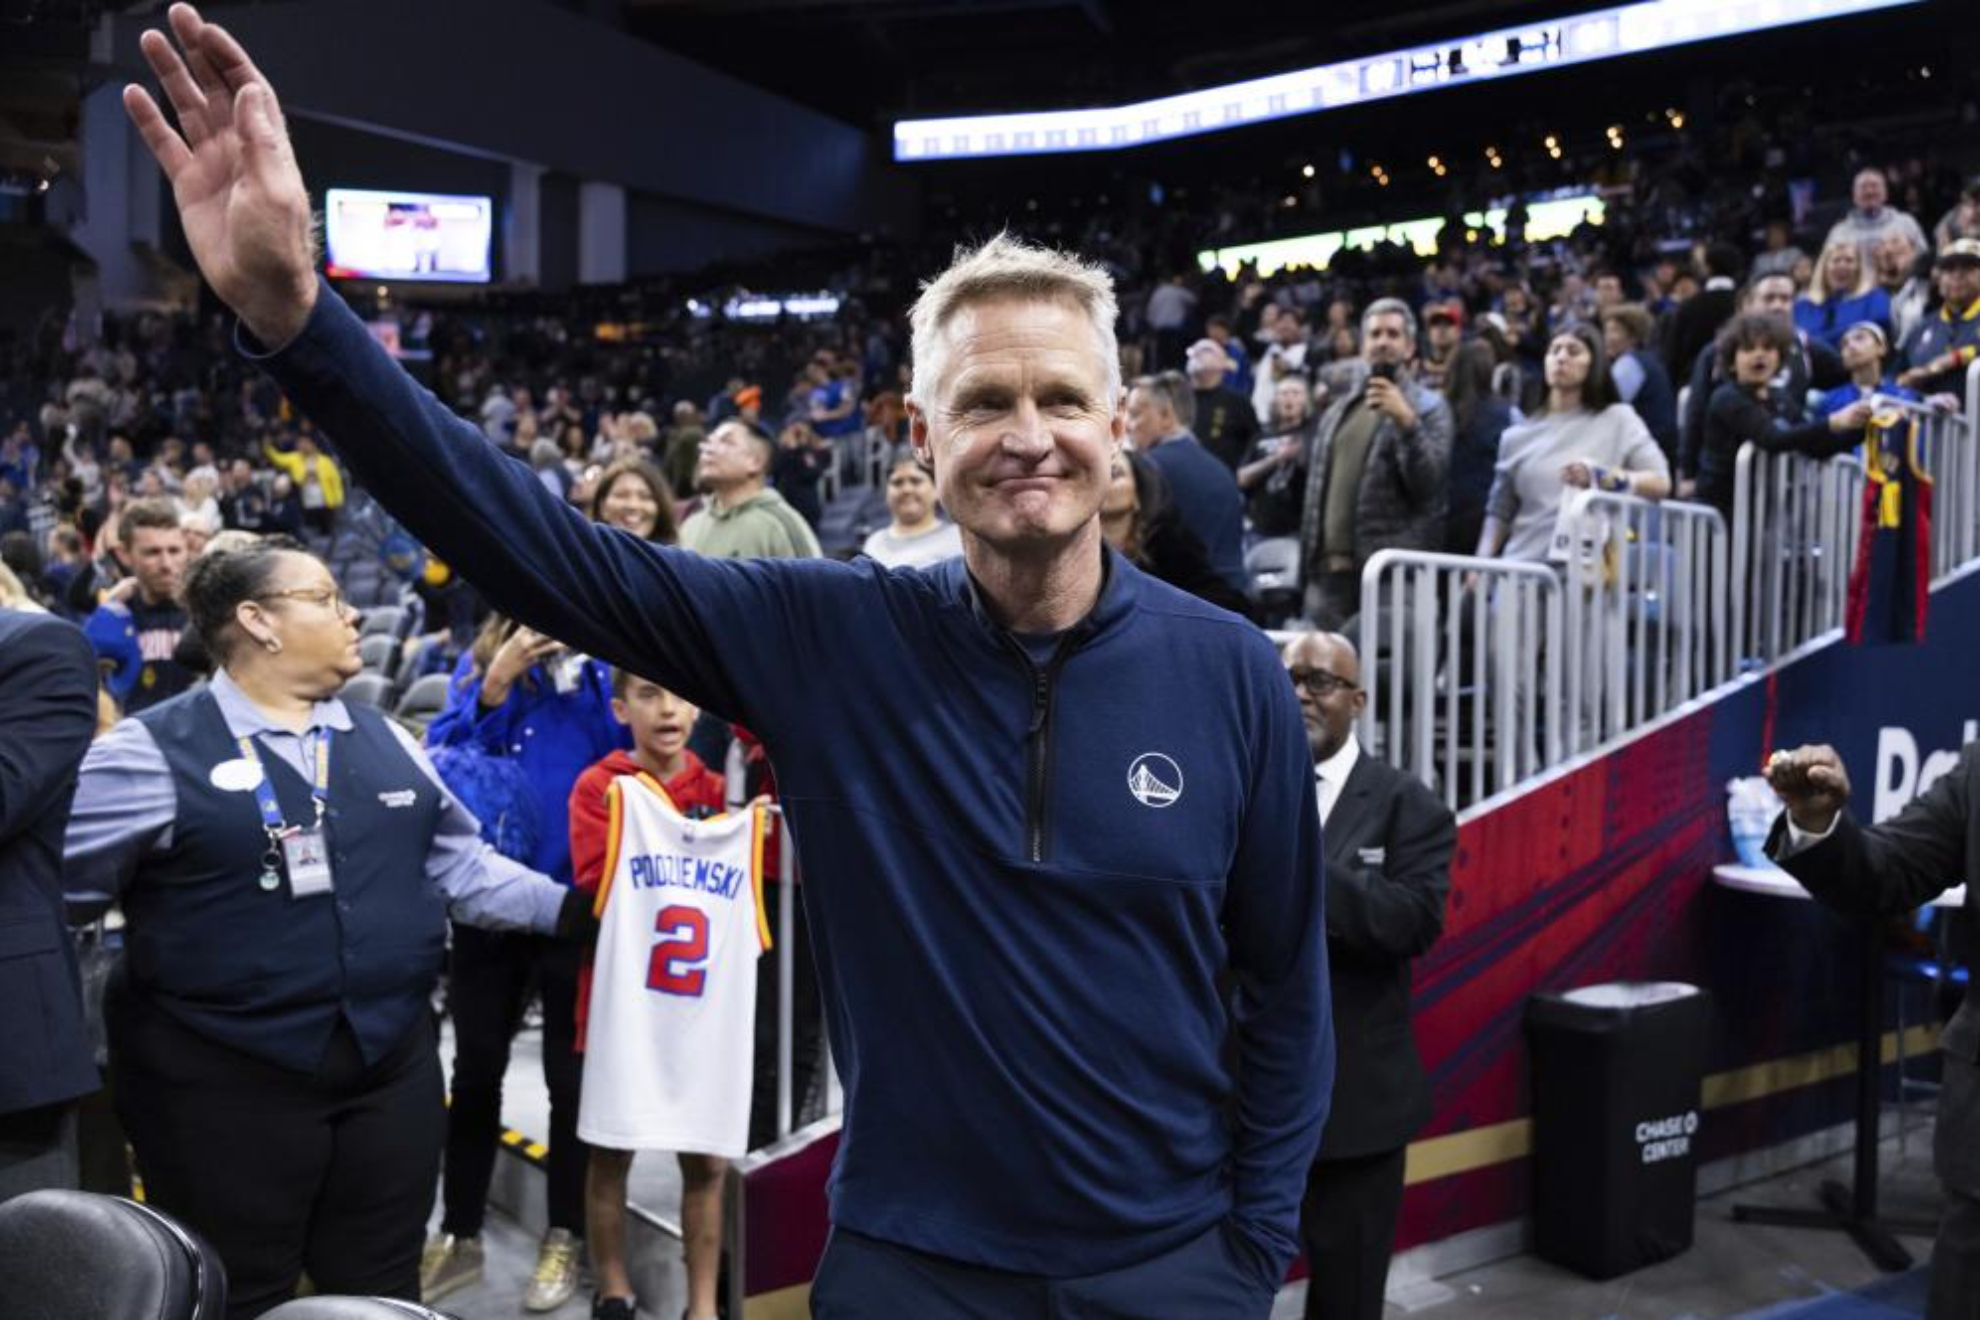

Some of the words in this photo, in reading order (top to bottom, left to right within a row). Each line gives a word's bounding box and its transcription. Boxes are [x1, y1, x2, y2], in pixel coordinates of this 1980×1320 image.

[630, 855, 743, 900] PODZIEMSKI
[645, 904, 710, 998] 2
[1635, 1116, 1683, 1142] CHASE
[1641, 1137, 1689, 1163] CENTER
